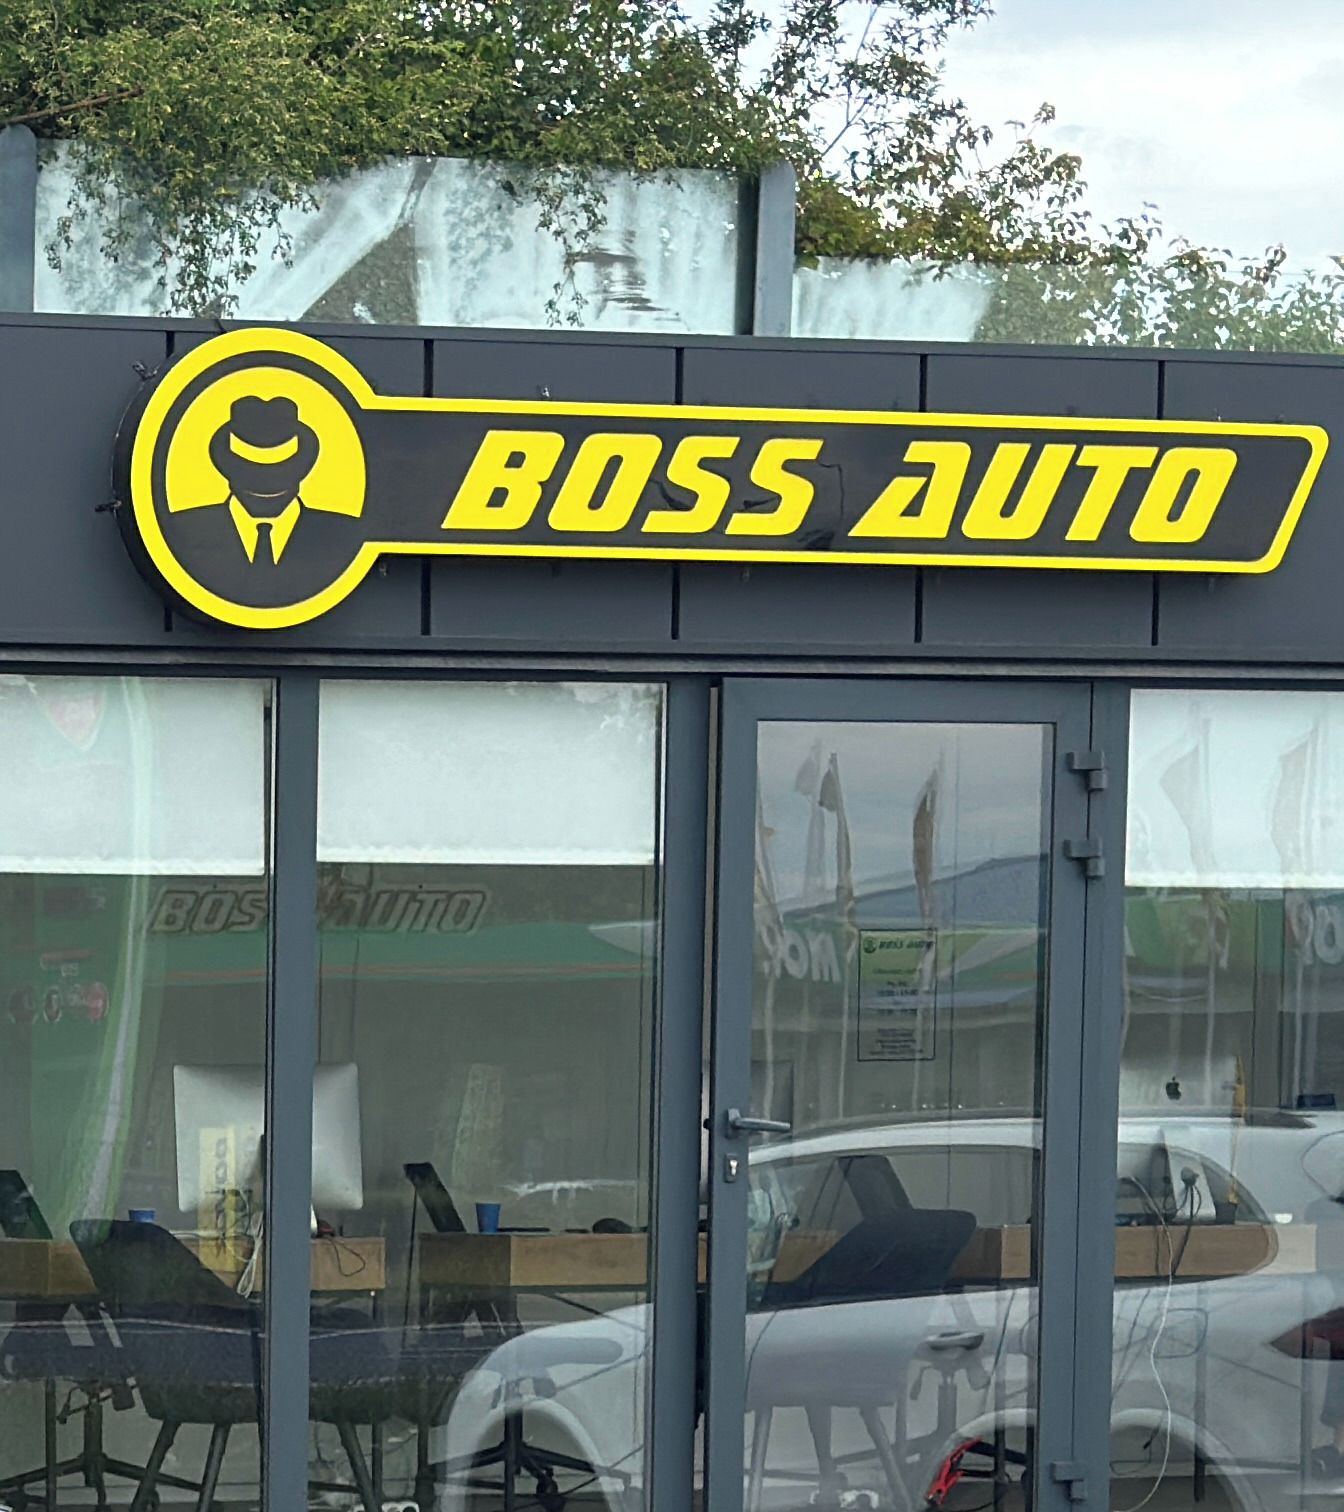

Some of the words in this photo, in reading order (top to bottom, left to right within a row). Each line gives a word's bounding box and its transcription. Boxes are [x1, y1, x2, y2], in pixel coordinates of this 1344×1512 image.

[441, 429, 823, 537] BOSS
[847, 440, 1239, 544] AUTO
[150, 889, 266, 934] BOS
